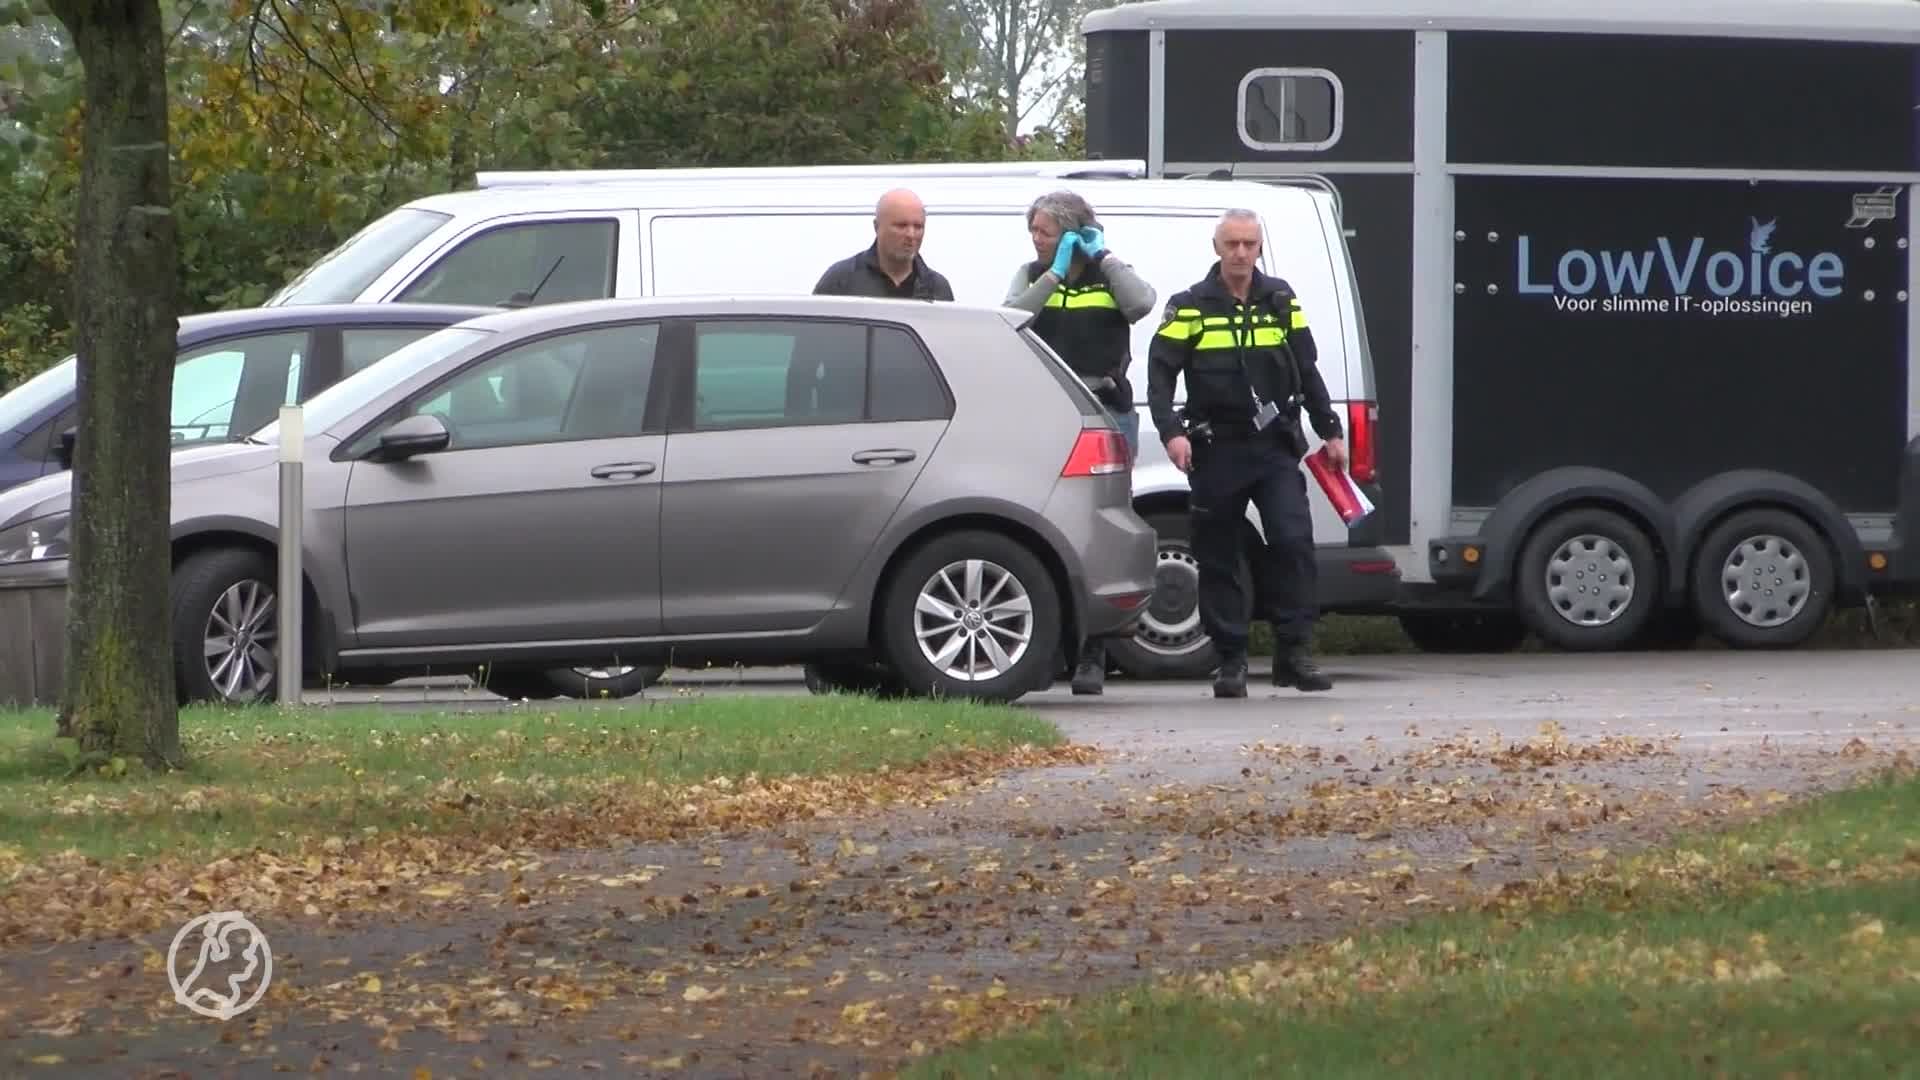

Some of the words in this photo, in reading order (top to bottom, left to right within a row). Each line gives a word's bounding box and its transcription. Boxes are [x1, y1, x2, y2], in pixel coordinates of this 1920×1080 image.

[1517, 233, 1844, 299] LowVoice
[1553, 295, 1597, 312] Voor
[1602, 295, 1669, 312] slimme
[1675, 296, 1812, 317] IT-oplossingen
